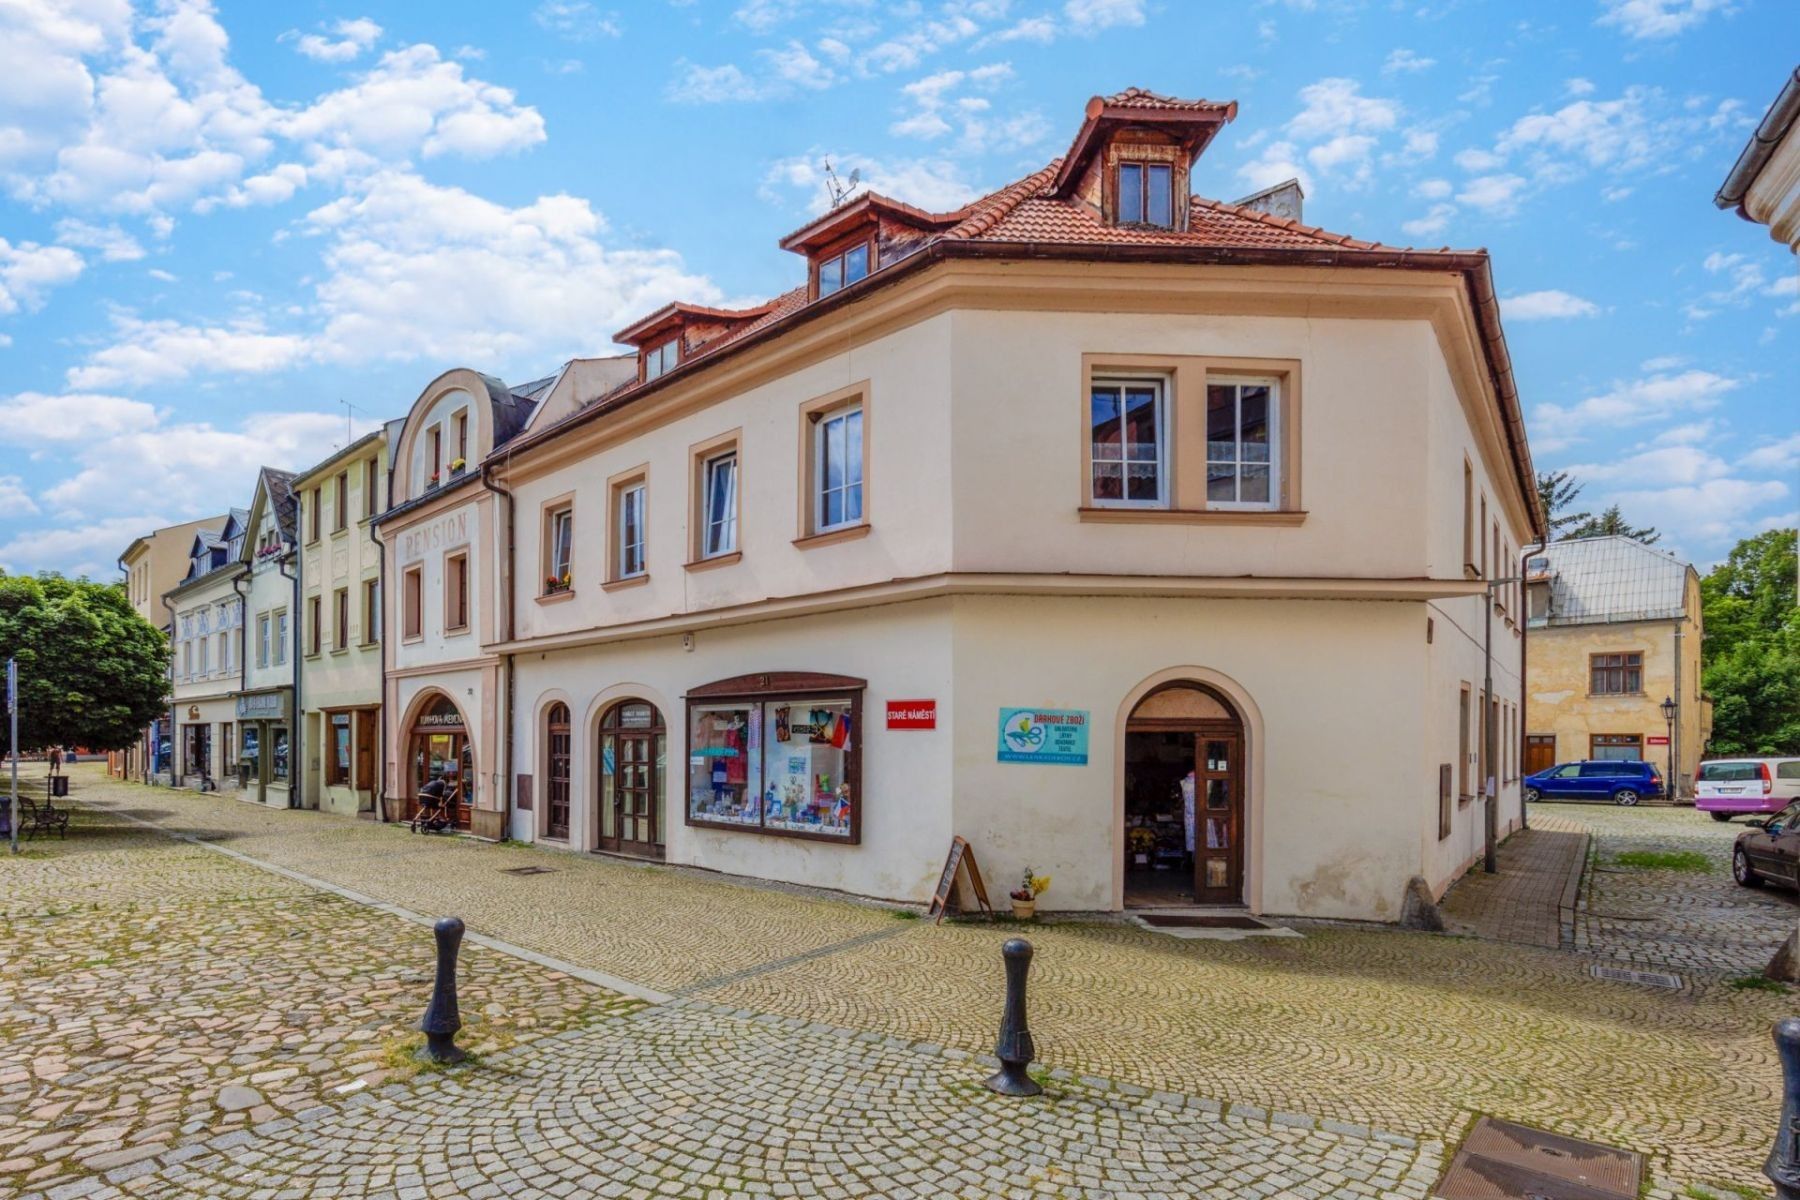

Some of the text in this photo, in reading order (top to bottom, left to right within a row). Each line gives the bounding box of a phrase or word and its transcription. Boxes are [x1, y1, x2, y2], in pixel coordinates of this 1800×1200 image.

[405, 511, 467, 560] PENSION
[887, 708, 935, 720] STARÉ NÁMĚSTÍ
